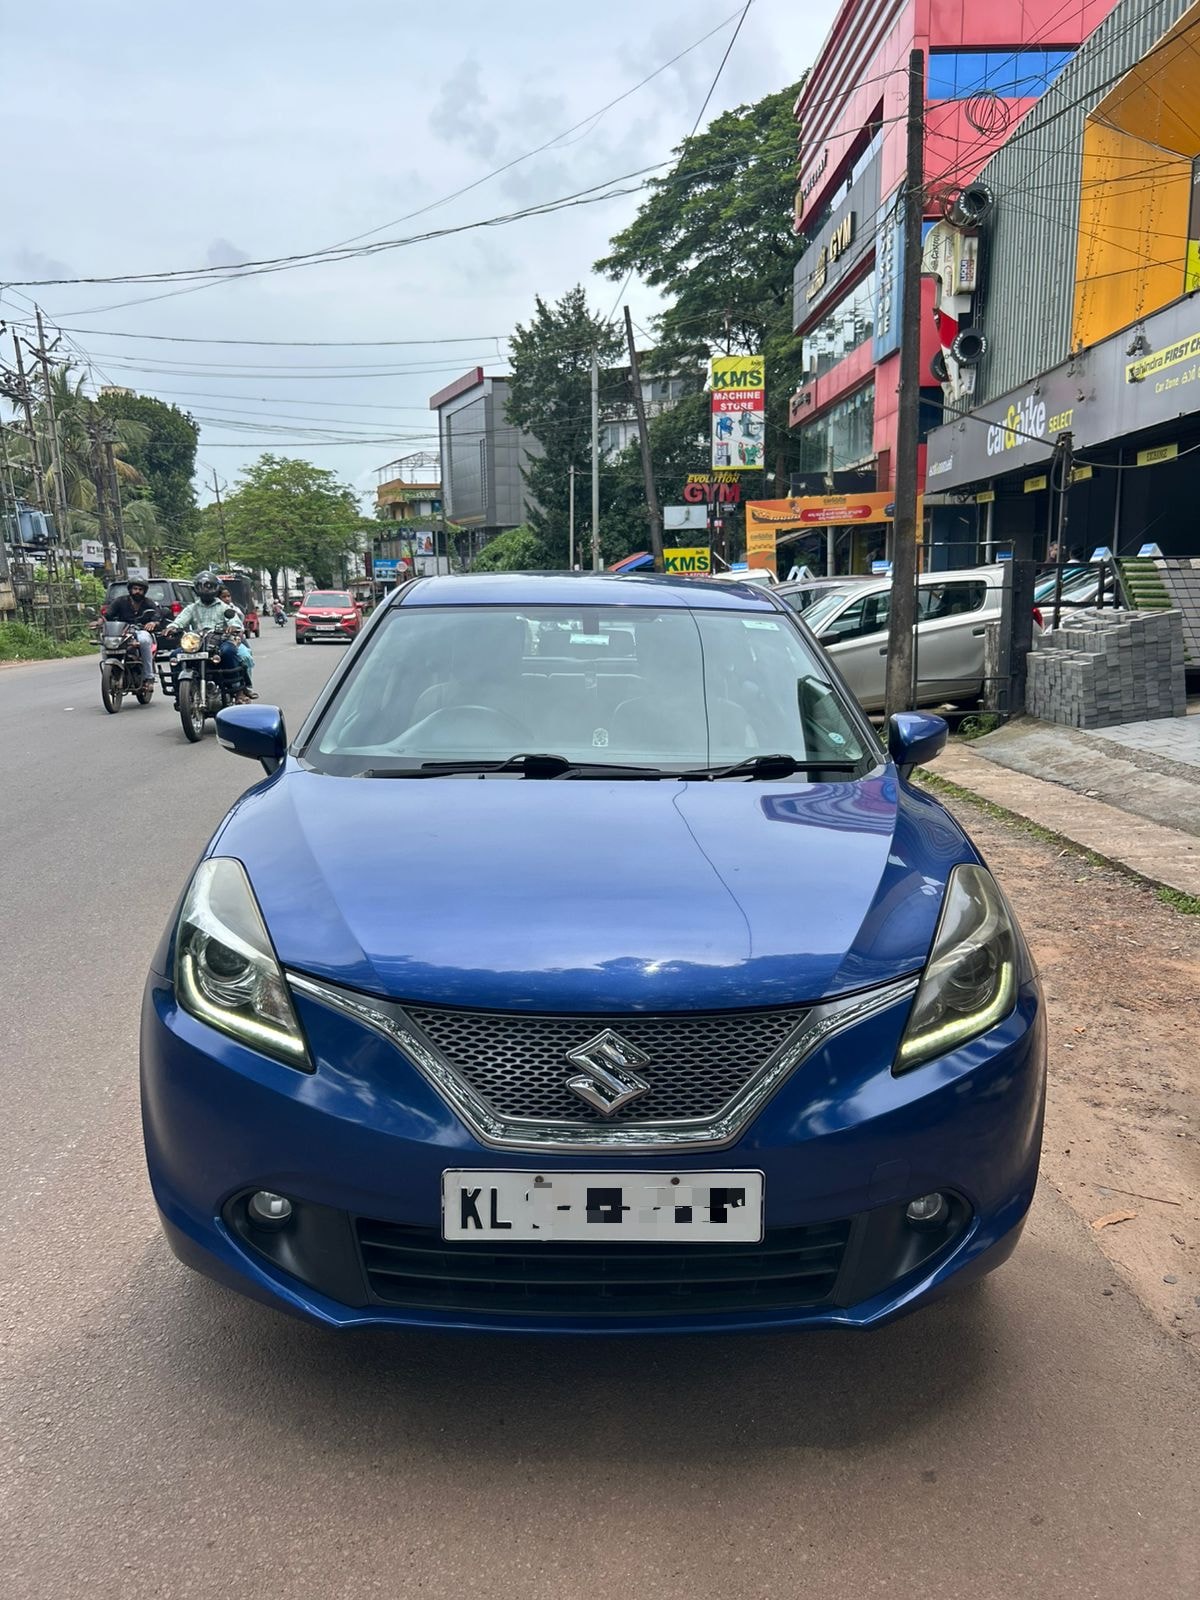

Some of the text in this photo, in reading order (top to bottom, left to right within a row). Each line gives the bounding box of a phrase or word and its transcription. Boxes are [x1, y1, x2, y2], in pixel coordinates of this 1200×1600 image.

[829, 211, 852, 263] GYM
[1130, 357, 1163, 379] ahindra
[1164, 342, 1190, 364] FIRST
[713, 370, 762, 388] KMS
[713, 391, 761, 400] MACHINE
[720, 402, 754, 411] STORE
[987, 395, 1074, 456] car&bike SELECT
[684, 483, 740, 503] GYM
[665, 556, 709, 571] KMS
